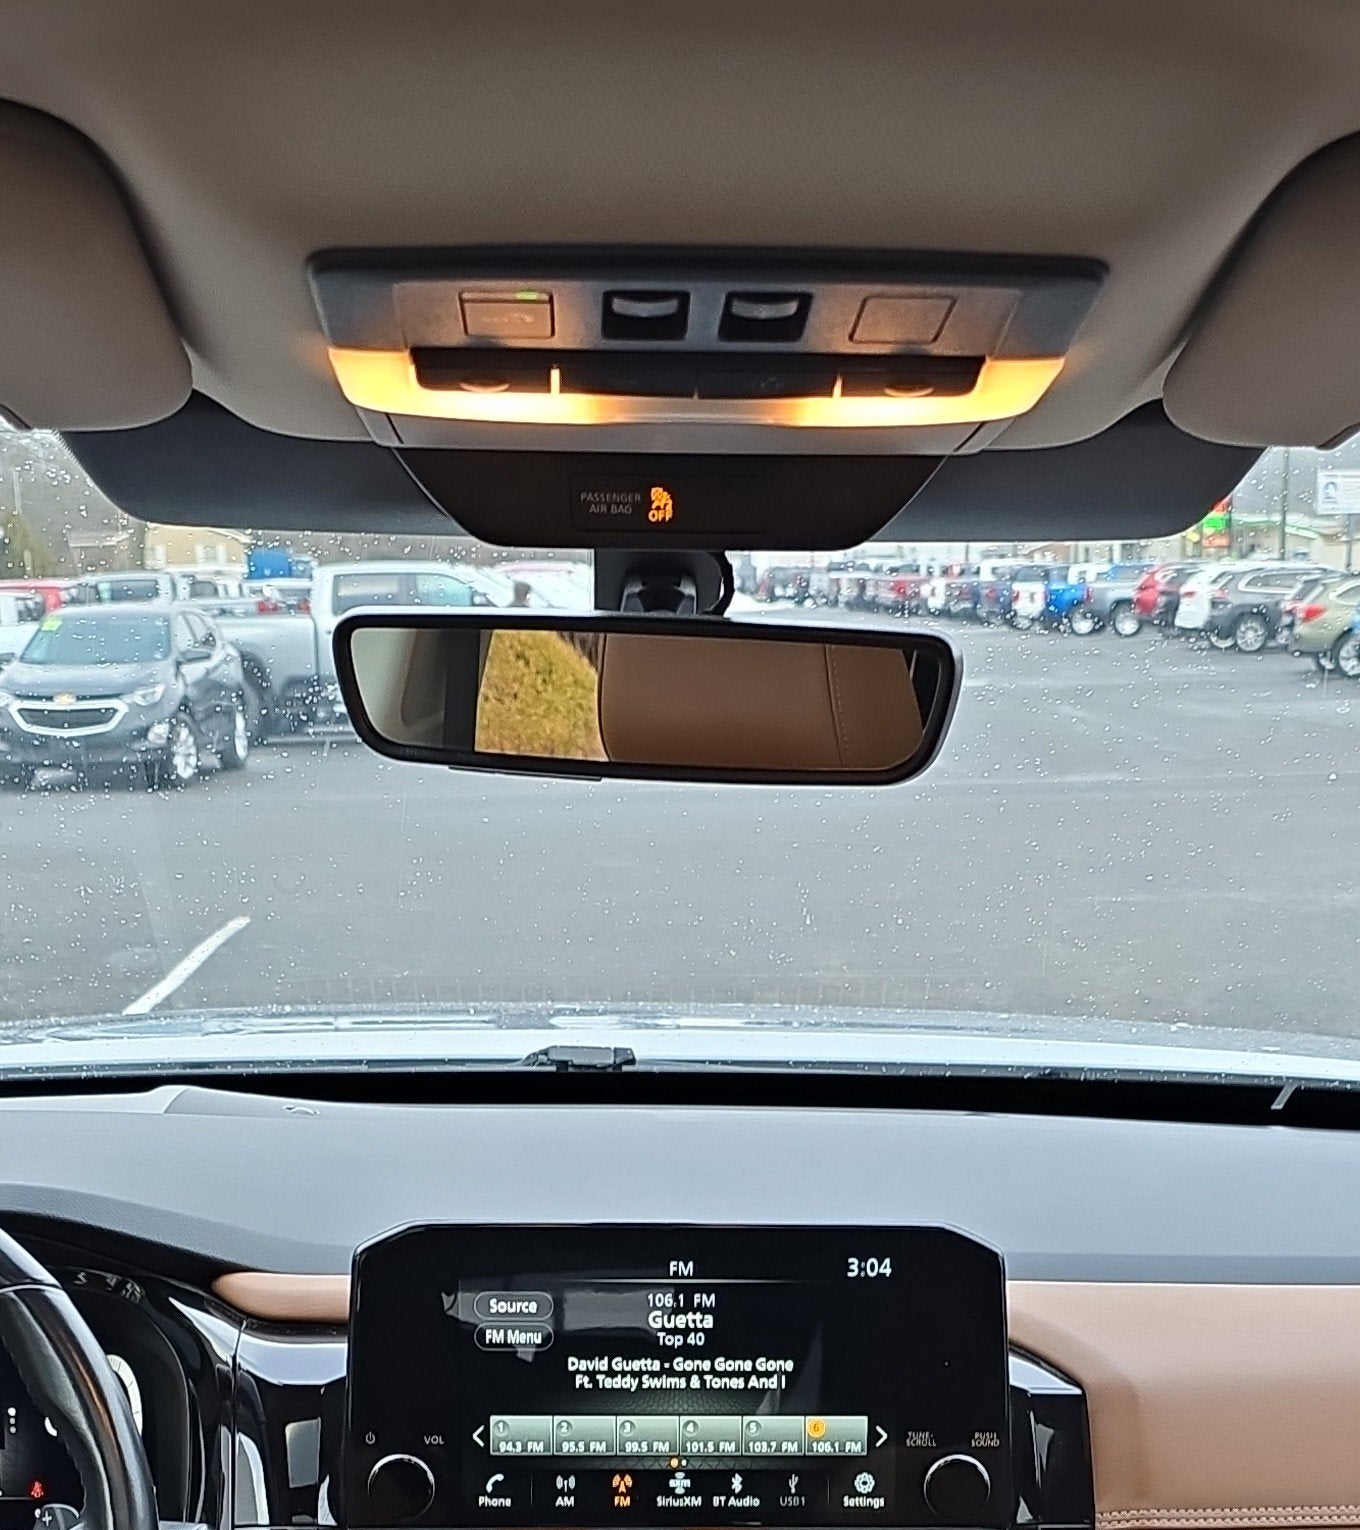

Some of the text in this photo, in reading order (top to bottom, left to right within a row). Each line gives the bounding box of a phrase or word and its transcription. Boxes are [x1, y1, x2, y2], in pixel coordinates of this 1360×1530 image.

[580, 492, 641, 503] PASSENGER
[588, 504, 632, 515] AIR BAG
[648, 509, 673, 522] OFF
[669, 1261, 694, 1277] FM
[846, 1258, 892, 1278] 3:04
[489, 1299, 538, 1314] Source
[647, 1293, 716, 1308] 106.1 FM
[648, 1310, 714, 1330] Guetta
[485, 1330, 543, 1345] FM Menu
[656, 1332, 705, 1349] Top 40
[567, 1356, 609, 1372] David
[611, 1356, 660, 1372] Guetta
[673, 1357, 711, 1372] Gone
[714, 1357, 752, 1372] Gone
[755, 1357, 794, 1372] Gone
[575, 1374, 593, 1389] Ft.
[596, 1374, 639, 1392] Teddy
[641, 1374, 687, 1390] Swims
[690, 1374, 701, 1390] &
[703, 1374, 745, 1390] Tones
[747, 1374, 778, 1390] And
[498, 1422, 506, 1433] 1
[560, 1422, 569, 1433] 2
[623, 1422, 632, 1433] 3
[685, 1422, 694, 1433] 4
[749, 1422, 757, 1433] 5
[812, 1422, 820, 1433] 6
[423, 1435, 445, 1445] VOL
[527, 1440, 544, 1453] FM
[590, 1440, 607, 1453] FM
[653, 1440, 670, 1453] FM
[685, 1440, 735, 1453] 101.5 FM
[748, 1440, 798, 1453] 103.7 FM
[811, 1440, 862, 1453] 106.1 FM
[971, 1439, 1000, 1448] SOUND
[478, 1495, 512, 1508] Phone
[555, 1496, 574, 1507] AM
[614, 1496, 631, 1507] FM
[656, 1495, 702, 1508] SiriusXM
[712, 1495, 761, 1508] BT Audio
[779, 1496, 806, 1507] USB1
[843, 1495, 885, 1510] Settings
